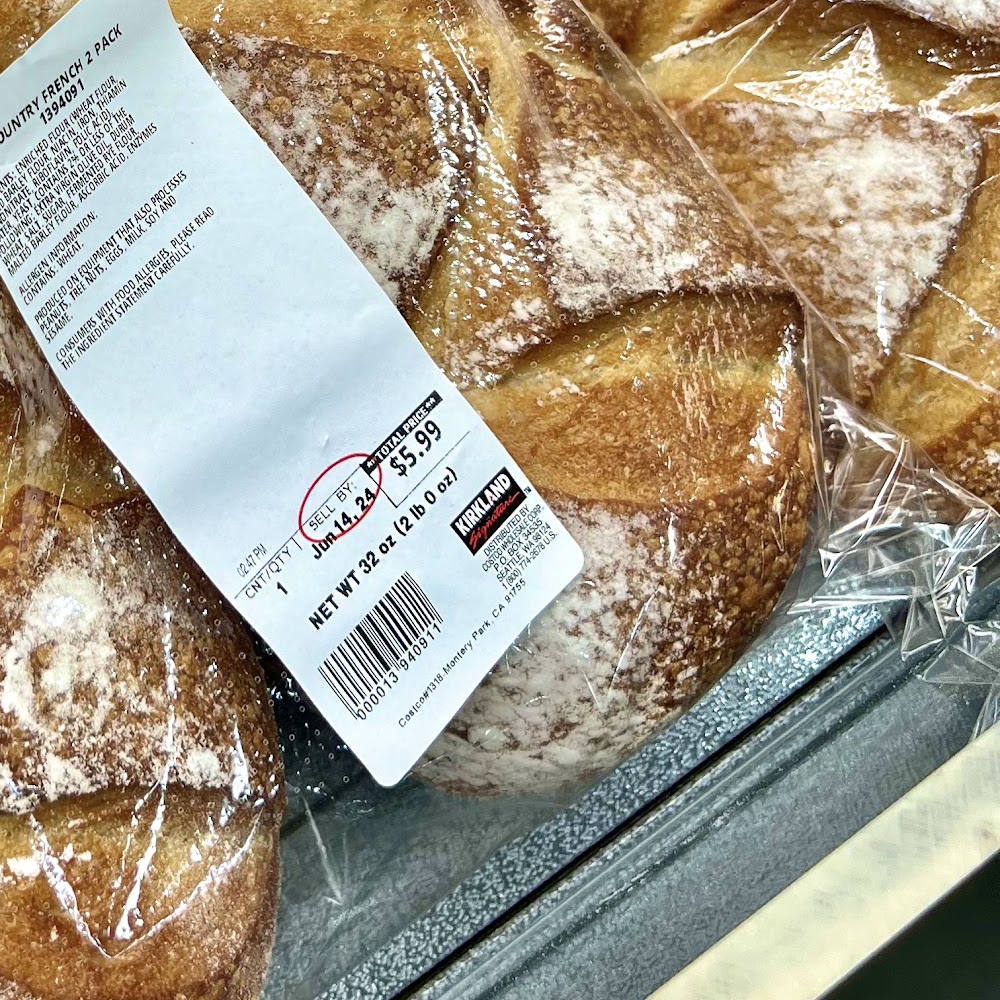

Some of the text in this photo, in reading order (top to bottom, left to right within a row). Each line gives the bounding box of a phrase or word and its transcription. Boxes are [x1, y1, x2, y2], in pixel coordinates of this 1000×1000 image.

[40, 58, 84, 104] FRENCH
[83, 50, 94, 65] 2
[93, 23, 123, 56] PACK
[15, 138, 49, 174] ENRICHED
[47, 118, 71, 143] FLOUR
[68, 93, 95, 124] (WHEAT
[94, 74, 118, 99] FLOUR,
[39, 78, 85, 125] 1394091
[3, 172, 28, 202] BARLEY
[26, 151, 52, 178] FLOUR,
[50, 126, 78, 155] NIACIN,
[76, 107, 98, 130] IRON,
[96, 79, 127, 111] THIAMIN
[32, 145, 74, 188] RIBOFLAVIN,
[72, 125, 93, 148] FOLIC
[33, 191, 56, 216] EXTRA
[53, 168, 79, 196] VIRGIN
[77, 150, 98, 173] OLIVE
[109, 113, 135, 142] DURUM
[34, 163, 69, 201] CONTAINS
[78, 142, 91, 157] OR
[88, 128, 105, 147] LESS
[103, 118, 114, 133] OF
[112, 106, 127, 124] THE
[41, 196, 68, 223] SUGAR,
[65, 158, 104, 199] FERMENTED
[102, 146, 116, 163] RYE
[114, 126, 139, 151] FLOUR,
[7, 245, 32, 277] MALTED
[30, 220, 56, 250] BARLEY
[78, 167, 110, 203] ASCORBIC
[126, 122, 157, 155] ENZYMES
[18, 210, 98, 296] ALLERGEN INFORMATION:
[23, 239, 84, 306] CONTAINS: WHEAT.
[34, 169, 187, 325] PRODUCED ON EQUIPMENT THAT ALSO PROCESSES
[39, 298, 71, 334] PEANUTS,
[69, 280, 87, 301] TREE
[84, 262, 108, 286] NUTS,
[105, 243, 127, 266] EGGS,
[144, 208, 161, 228] SOY
[159, 194, 177, 214] AND
[55, 205, 214, 362] CONSUMERS WITH FOOD ALLERGIES, PLEASE READ
[61, 240, 195, 371] THE INGREDIENT STATEMENT CAREFULLY.
[44, 310, 73, 344] SESAME.
[388, 418, 443, 478] $5.99
[308, 481, 357, 531] SELL BY:
[310, 486, 377, 560] Jun 14, 24
[454, 472, 511, 537] KIRKLAND
[467, 490, 520, 550] Signature
[481, 503, 544, 572] COSTCO WHOLESALE CORP.
[483, 504, 530, 557] DISTRIBUTED BY
[507, 537, 524, 557] BOX
[521, 517, 543, 541] 34535
[244, 545, 293, 600] CNT/QTY
[252, 542, 267, 560] PM
[308, 465, 459, 630] NET WT 32 oz (2 lb 0 oz)
[496, 522, 551, 583] SEATTLE, WA 98124
[502, 530, 558, 590] 1 (800) 774-2678 U.S.
[276, 581, 288, 596] 1
[471, 618, 494, 641] Park,
[491, 603, 506, 619] CA
[504, 577, 526, 604] 91755
[356, 622, 441, 720] 000013 940911
